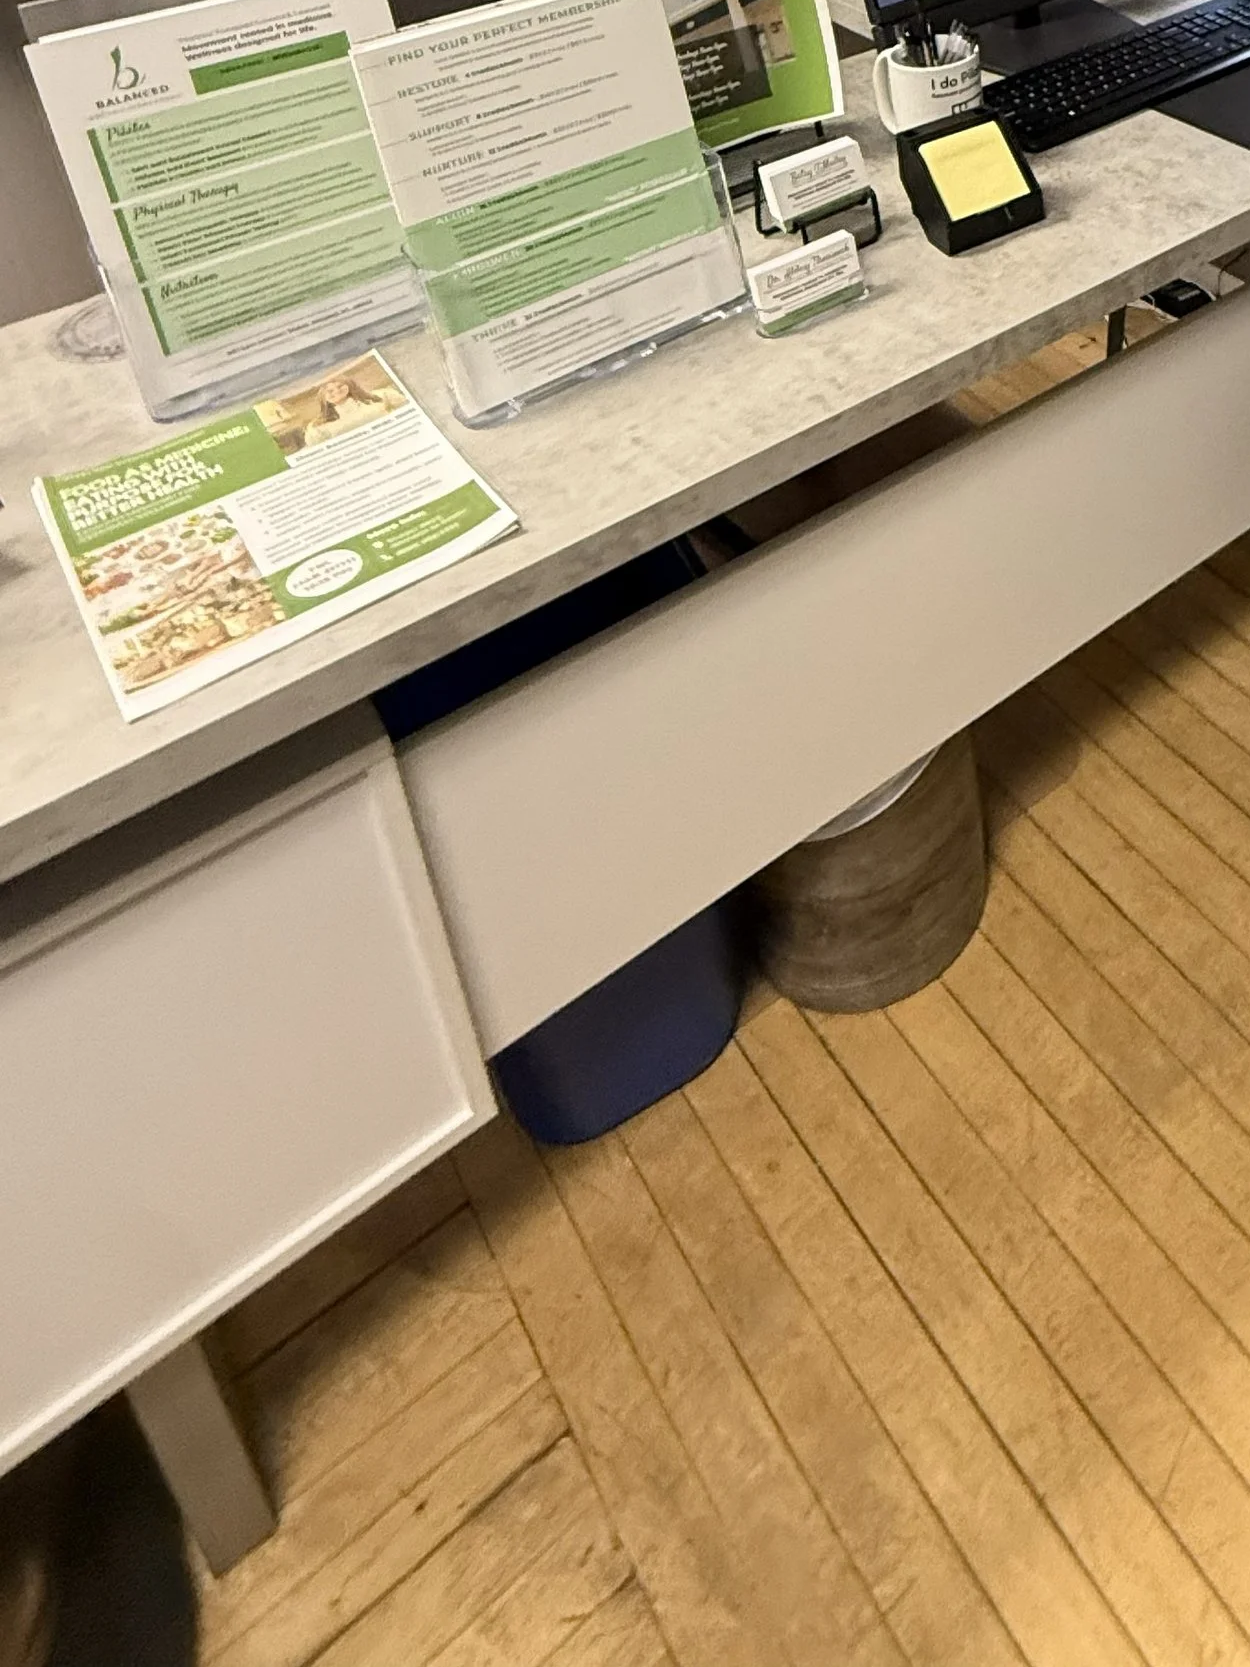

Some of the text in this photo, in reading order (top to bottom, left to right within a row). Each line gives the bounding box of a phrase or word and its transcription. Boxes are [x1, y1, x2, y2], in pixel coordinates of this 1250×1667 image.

[388, 48, 425, 67] FIND
[428, 36, 469, 55] YOUR
[473, 18, 534, 43] PERFECT
[95, 83, 170, 110] BALANCED
[931, 78, 936, 91] I
[940, 75, 958, 90] do
[133, 183, 239, 221] Physical Therapy
[160, 273, 219, 299] Nutrition
[60, 474, 121, 500] FOOD
[124, 462, 152, 484] AS
[62, 475, 141, 512] EATING
[141, 455, 196, 482] WITH
[66, 477, 163, 521] PURPOSE
[164, 460, 207, 484] FOR
[70, 495, 146, 531] BETTER
[145, 463, 224, 501] HEALTH
